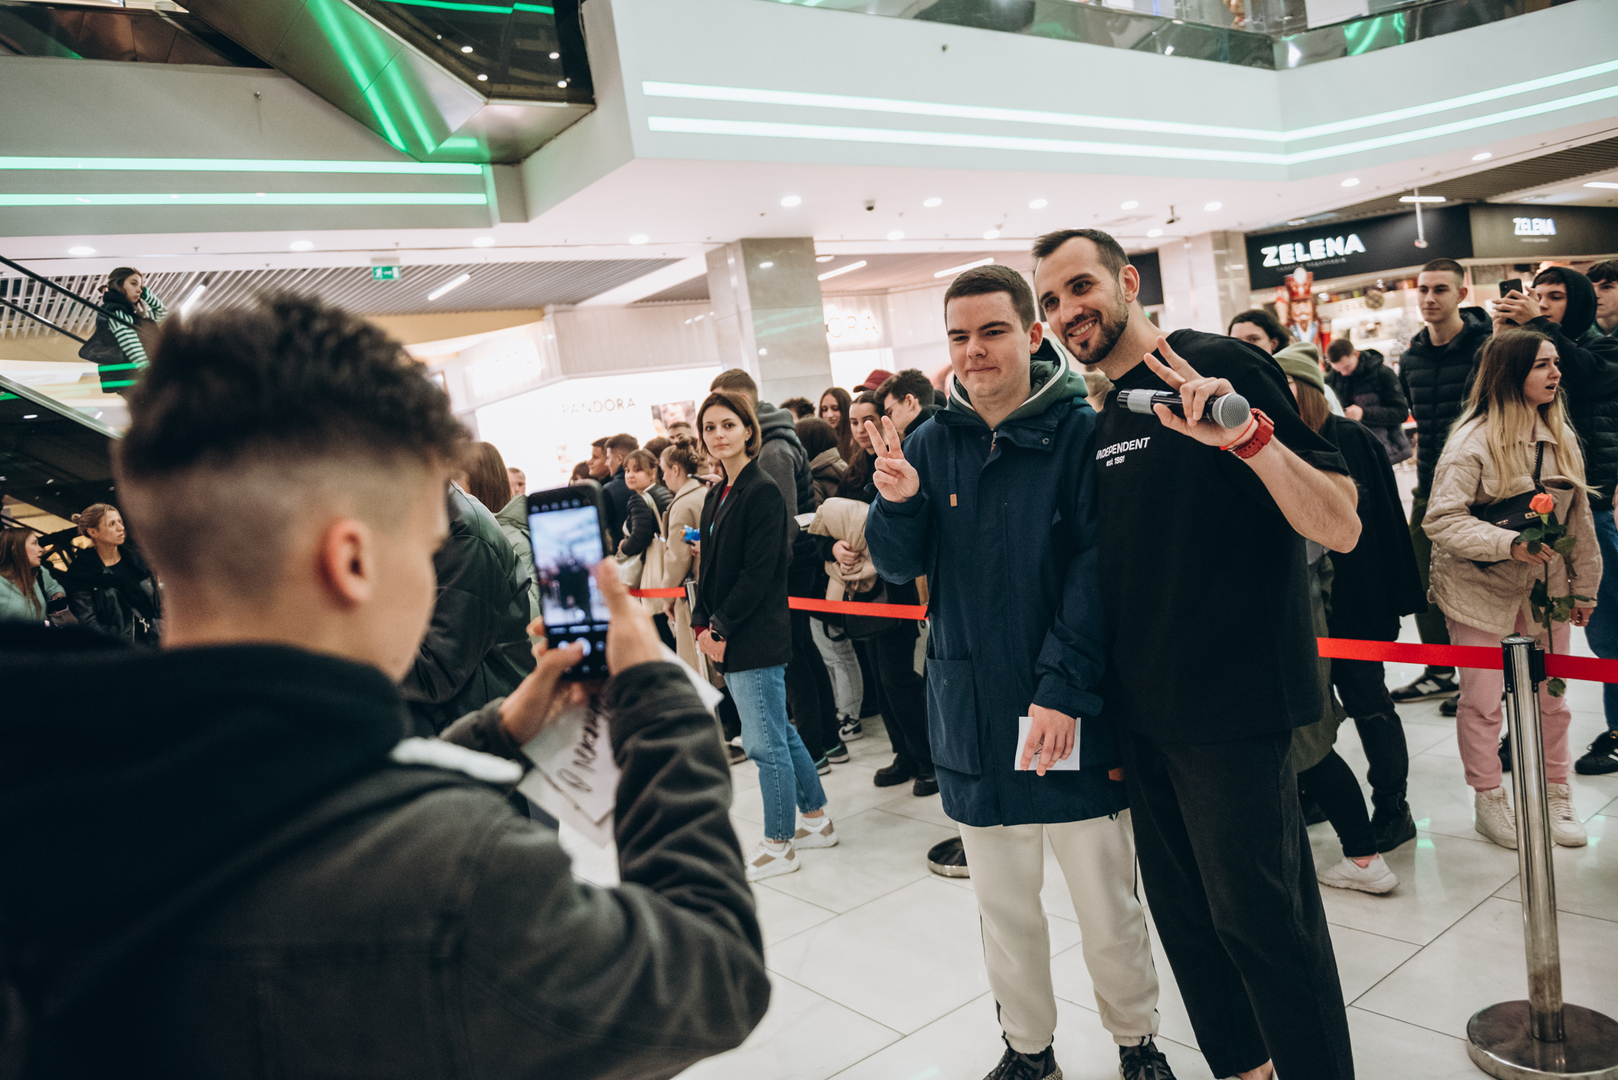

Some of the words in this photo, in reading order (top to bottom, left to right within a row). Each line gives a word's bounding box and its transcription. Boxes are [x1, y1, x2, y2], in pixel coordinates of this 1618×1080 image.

[1513, 217, 1557, 235] ZELENA
[1260, 233, 1366, 267] ZELENA
[827, 315, 880, 338] ORA
[561, 396, 637, 415] PANDORA
[1095, 436, 1151, 460] INDEPENDENT
